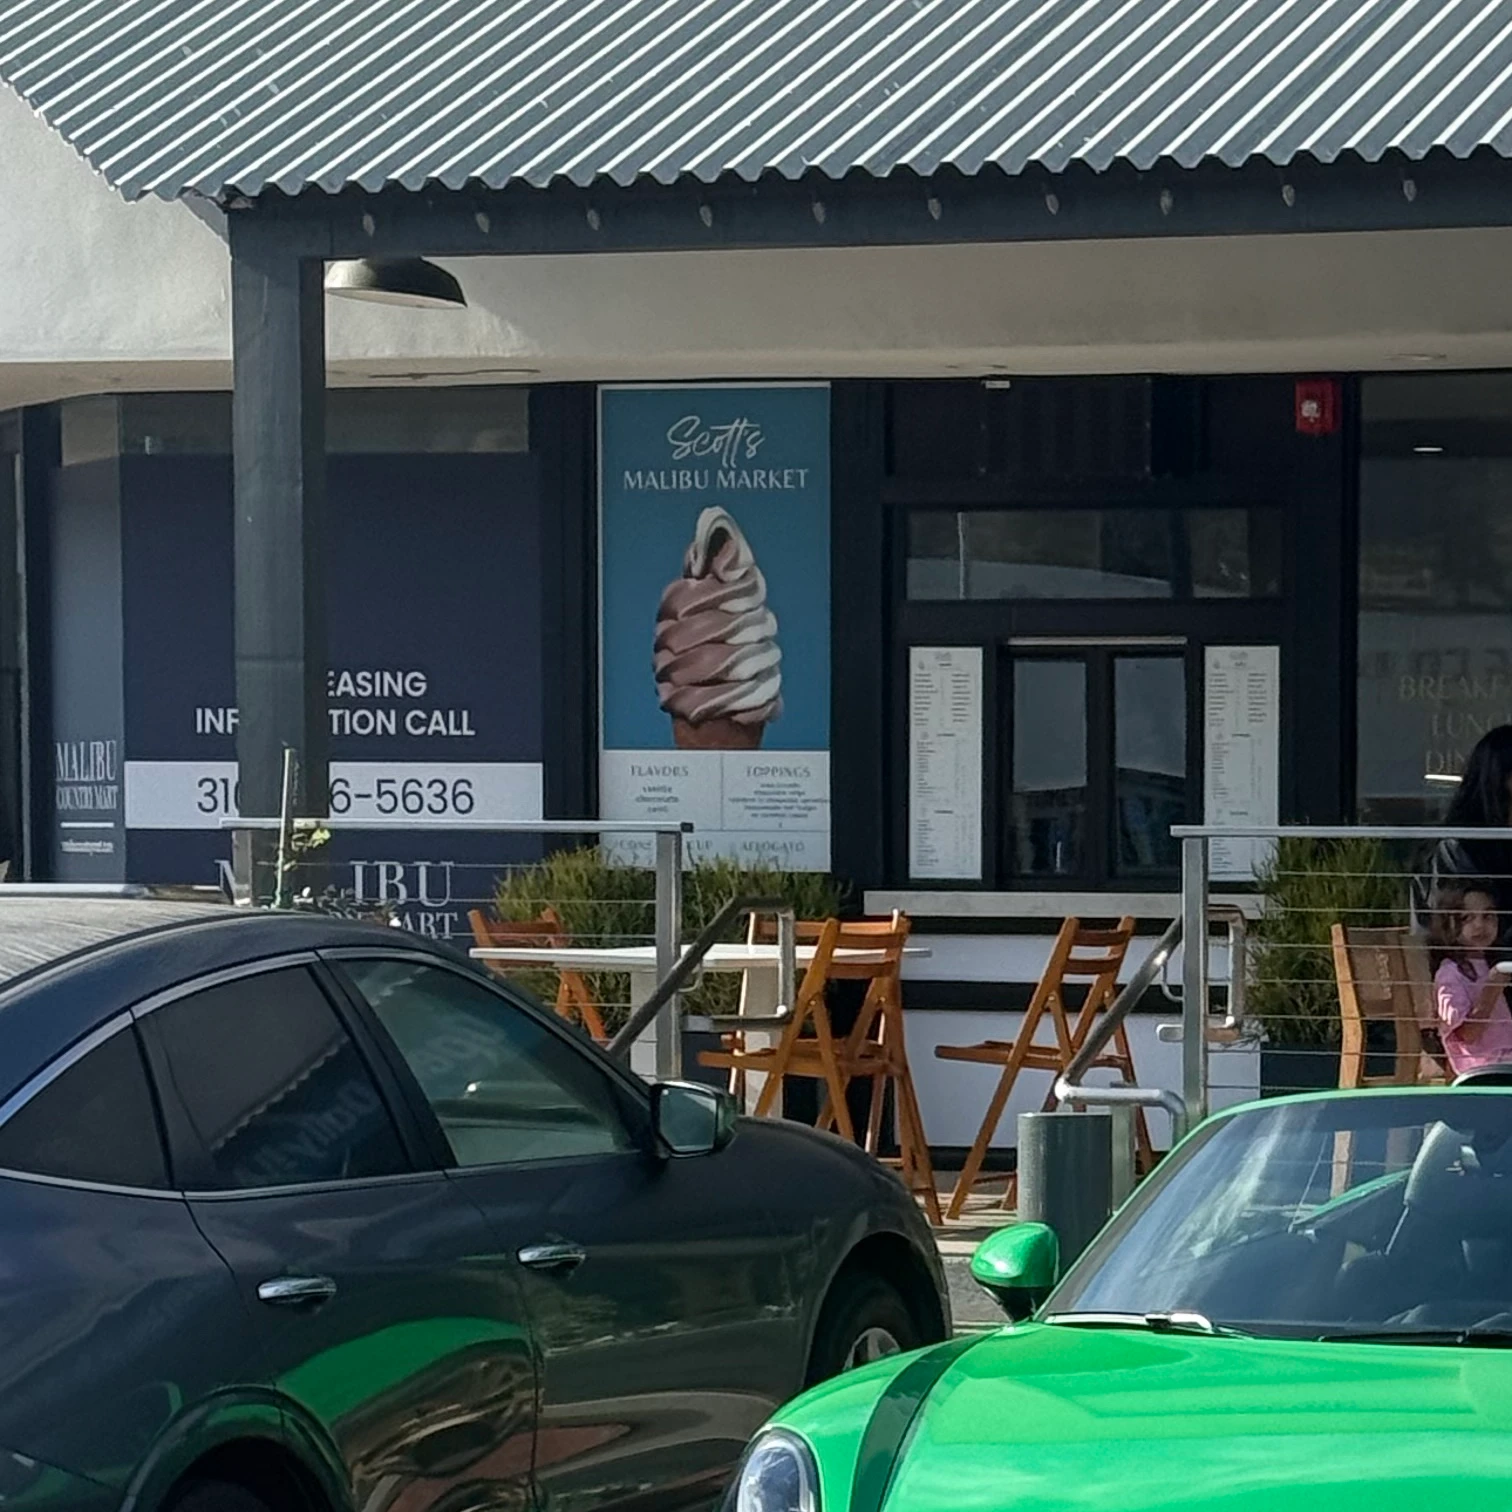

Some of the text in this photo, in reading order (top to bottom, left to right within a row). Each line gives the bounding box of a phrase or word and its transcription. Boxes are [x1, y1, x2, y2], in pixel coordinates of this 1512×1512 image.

[667, 415, 765, 468] Scott's
[624, 468, 809, 490] MALIBU MARKET
[327, 671, 427, 697] ASING
[405, 710, 475, 735] CALL
[56, 740, 117, 781] MALIBU
[400, 912, 458, 939] ART
